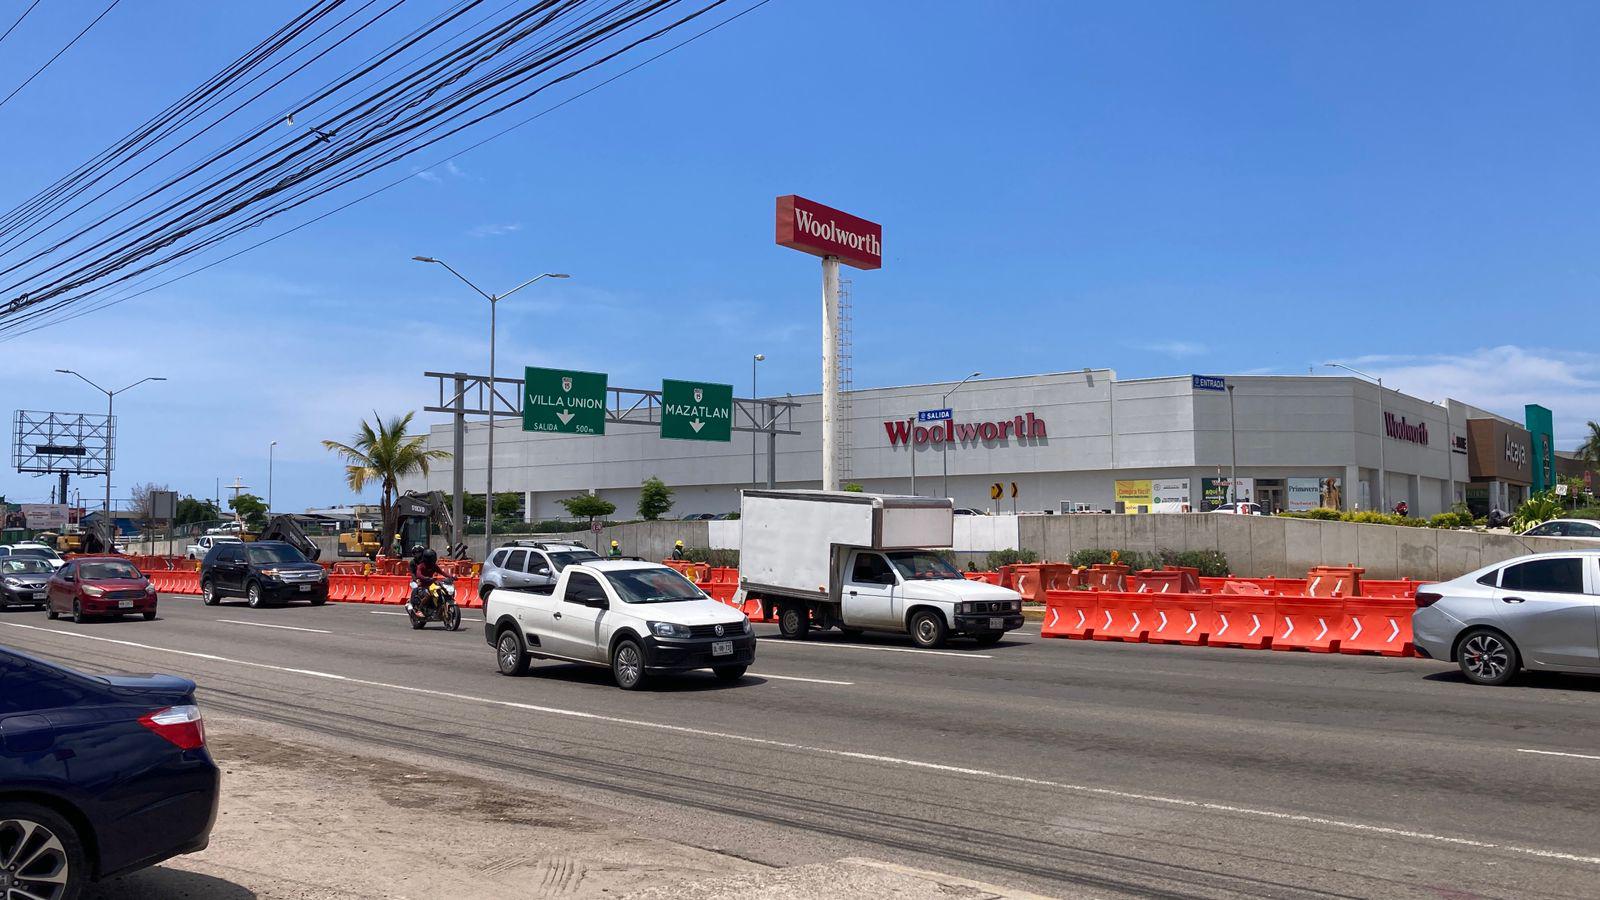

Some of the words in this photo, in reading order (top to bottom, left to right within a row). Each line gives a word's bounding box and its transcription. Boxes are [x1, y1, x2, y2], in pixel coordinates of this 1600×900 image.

[795, 207, 880, 256] Woolworth
[1200, 378, 1224, 388] ENTRADA
[529, 394, 563, 407] VILLA
[567, 397, 602, 410] UNION
[665, 403, 729, 419] MAZATLAN
[927, 411, 950, 420] SALIDA
[534, 422, 558, 431] SALIDA
[576, 425, 594, 433] 500m
[884, 412, 1047, 445] Woolworth
[1384, 411, 1429, 445] Woolworth
[1504, 432, 1526, 470] Acaya
[1289, 485, 1318, 493] Primavera
